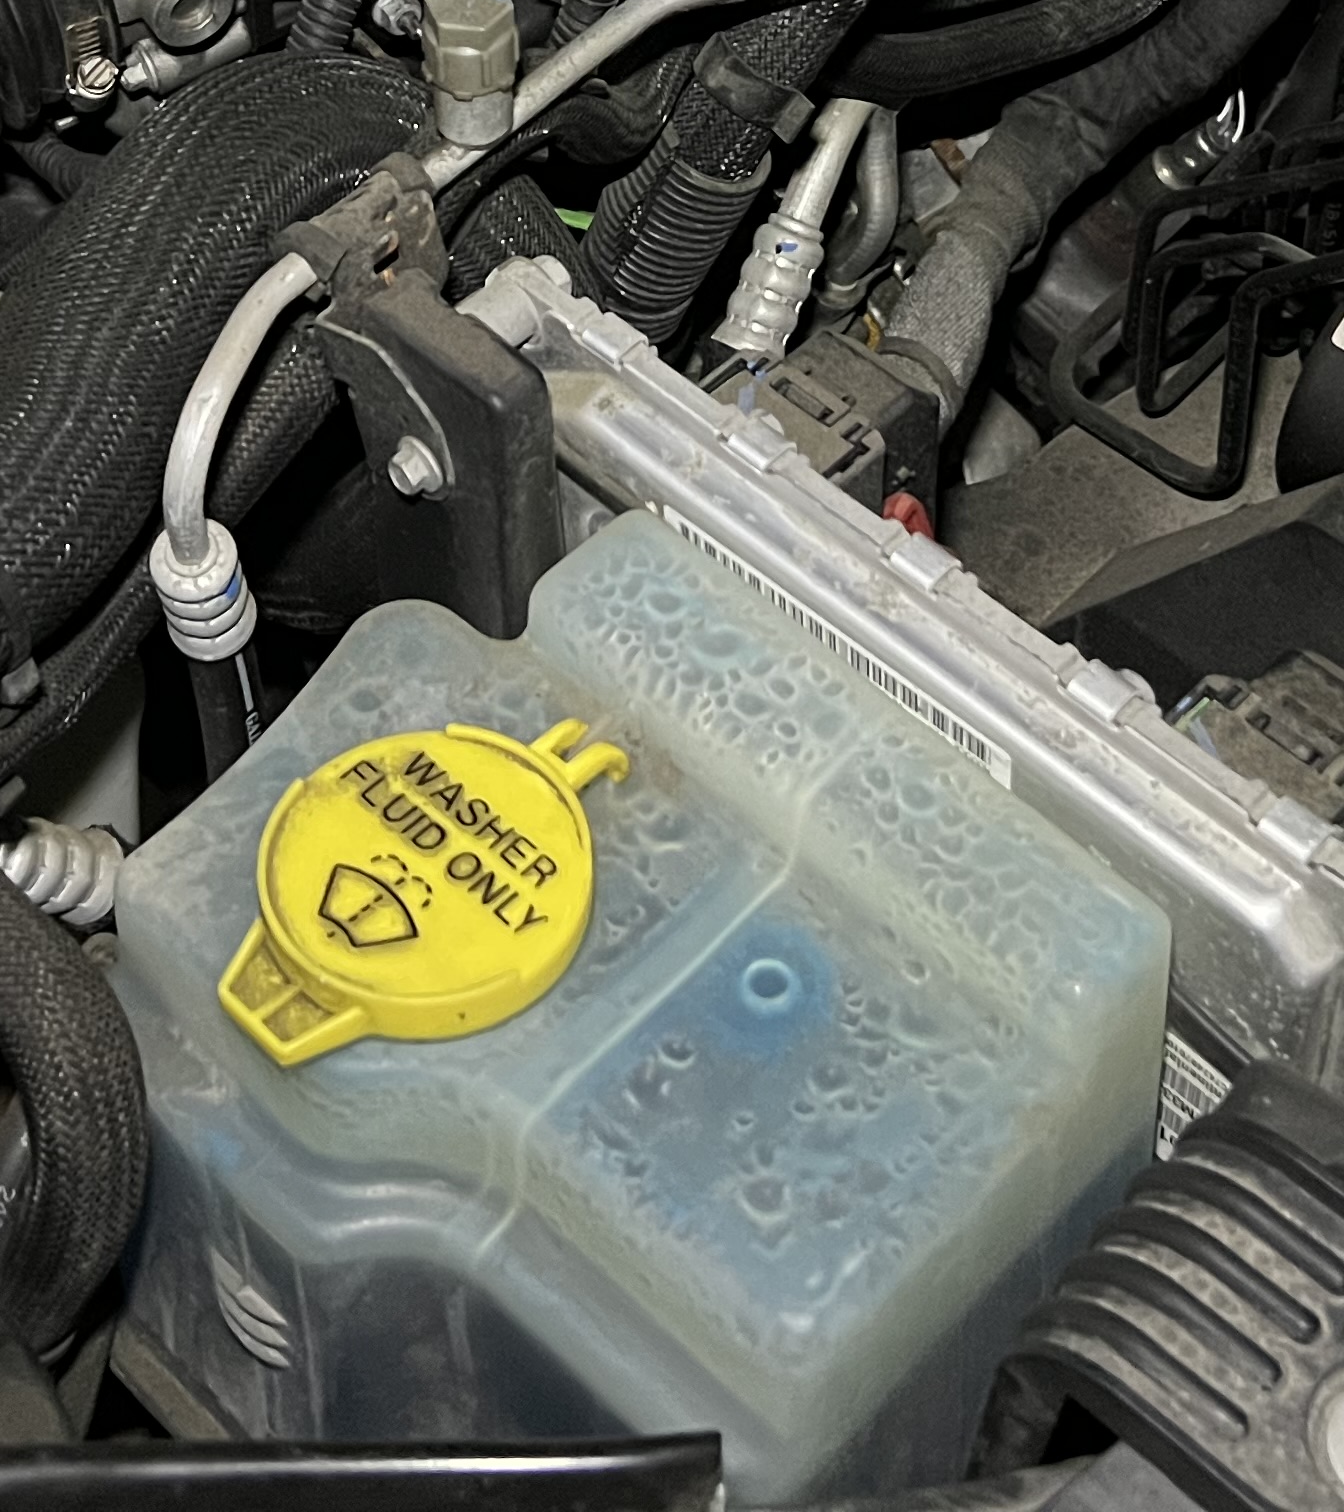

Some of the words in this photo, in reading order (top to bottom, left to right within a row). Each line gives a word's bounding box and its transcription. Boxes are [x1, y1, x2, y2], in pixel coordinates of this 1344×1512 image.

[339, 759, 448, 851] FLUID
[446, 851, 549, 934] ONLY
[405, 751, 558, 889] WASHER
